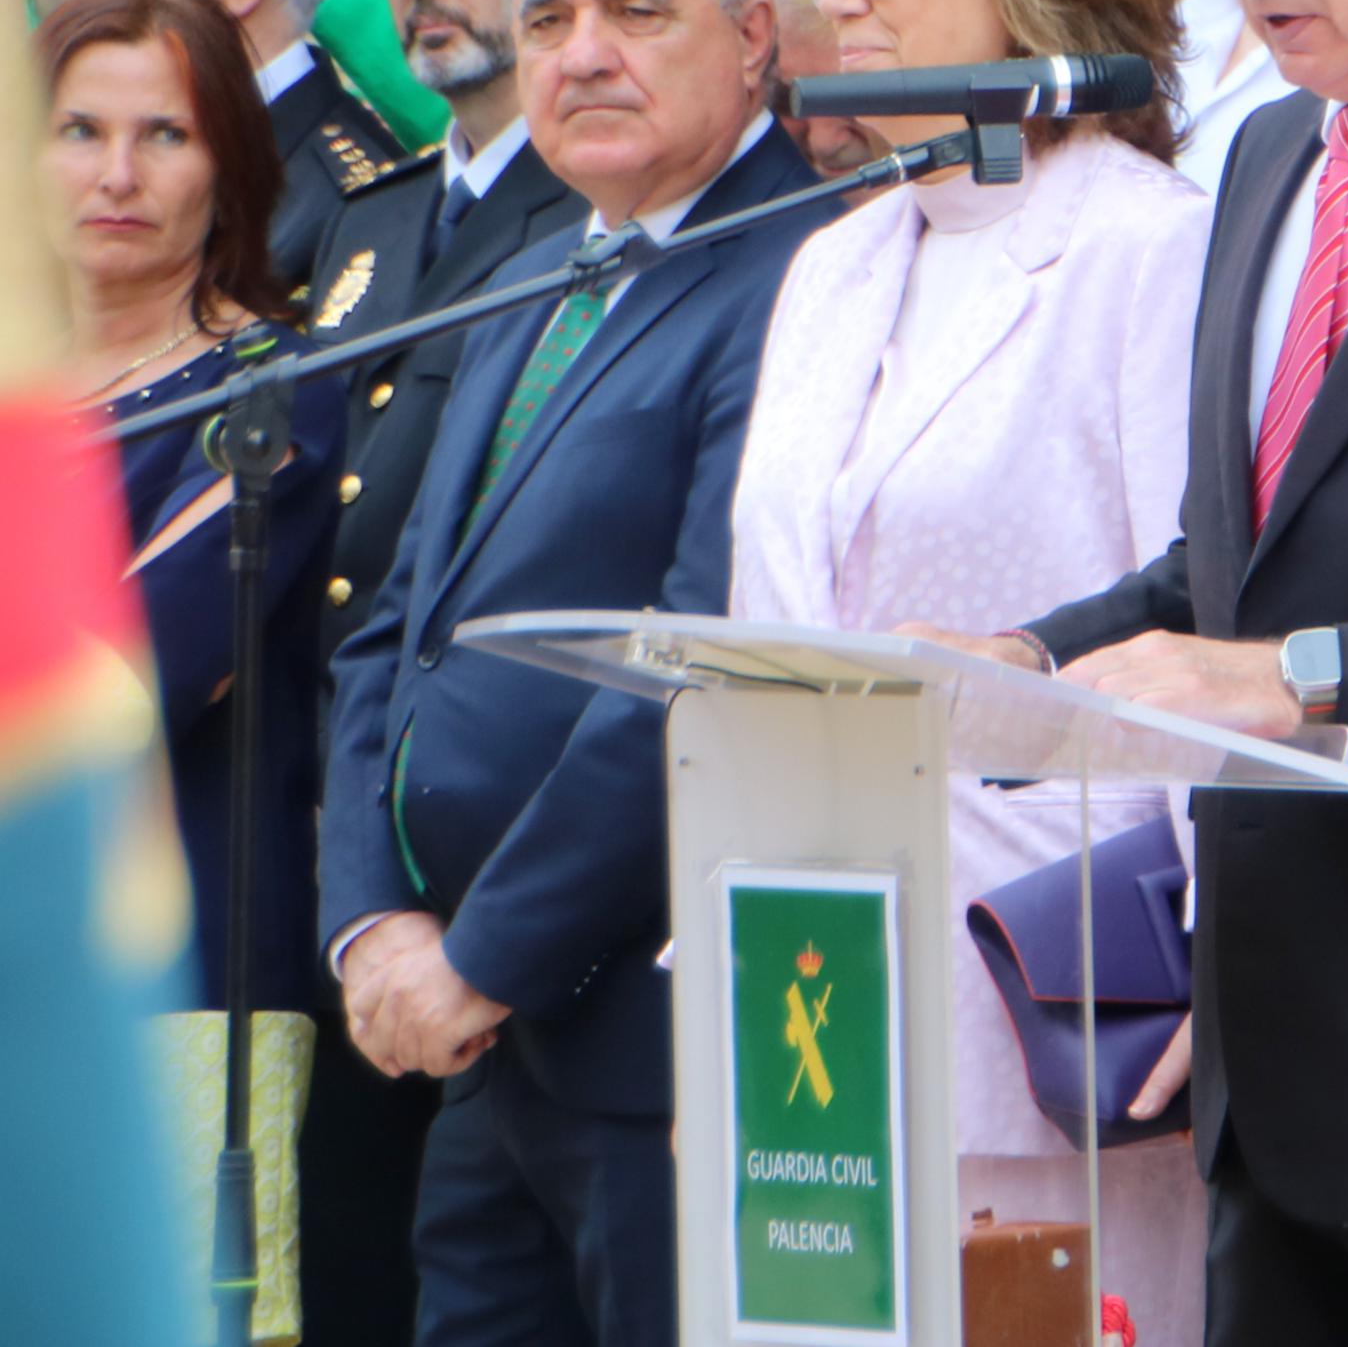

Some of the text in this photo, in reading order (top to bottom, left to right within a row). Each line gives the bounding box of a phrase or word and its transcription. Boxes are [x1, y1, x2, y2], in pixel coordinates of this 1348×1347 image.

[747, 1149, 878, 1187] GUARDIA CIVIL
[767, 1218, 854, 1254] PALENCIA
